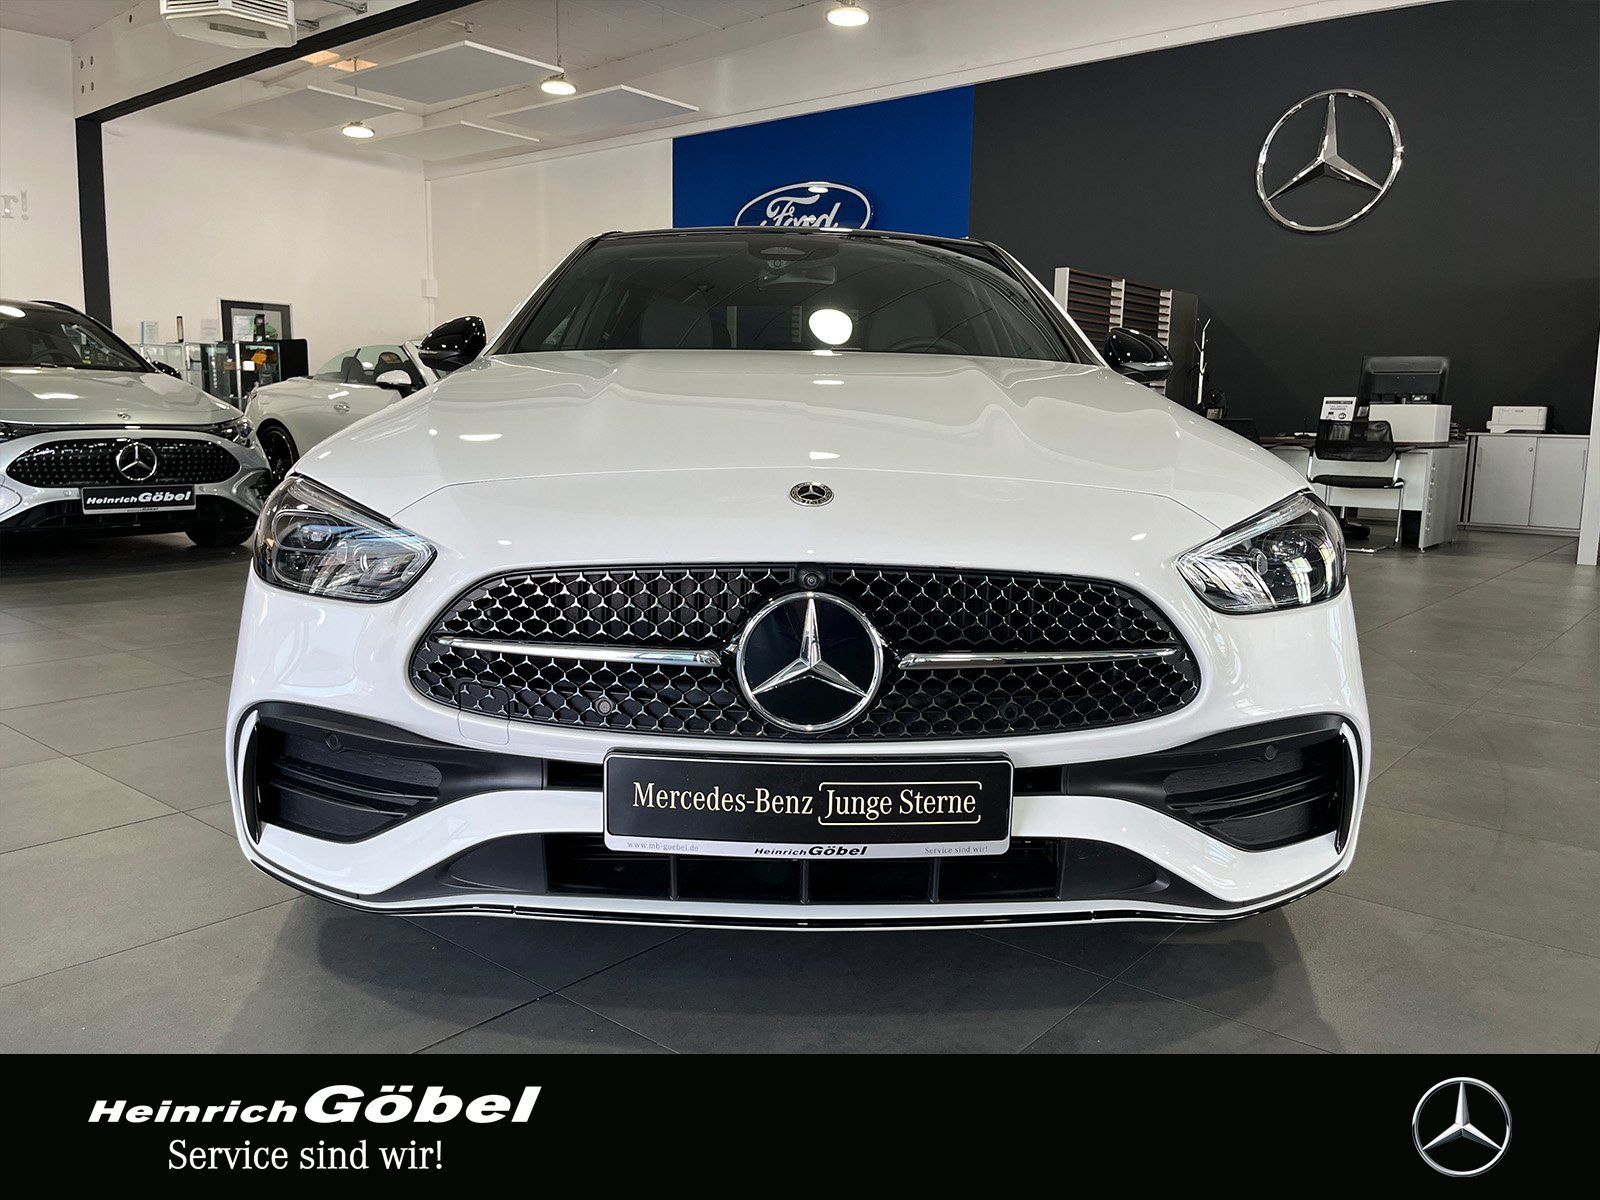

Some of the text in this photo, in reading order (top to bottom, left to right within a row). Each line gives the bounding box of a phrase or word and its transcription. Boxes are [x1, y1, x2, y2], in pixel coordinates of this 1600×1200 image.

[632, 781, 976, 821] Mercedes-Benz Junge Sterne
[924, 845, 988, 855] Service sind wir!
